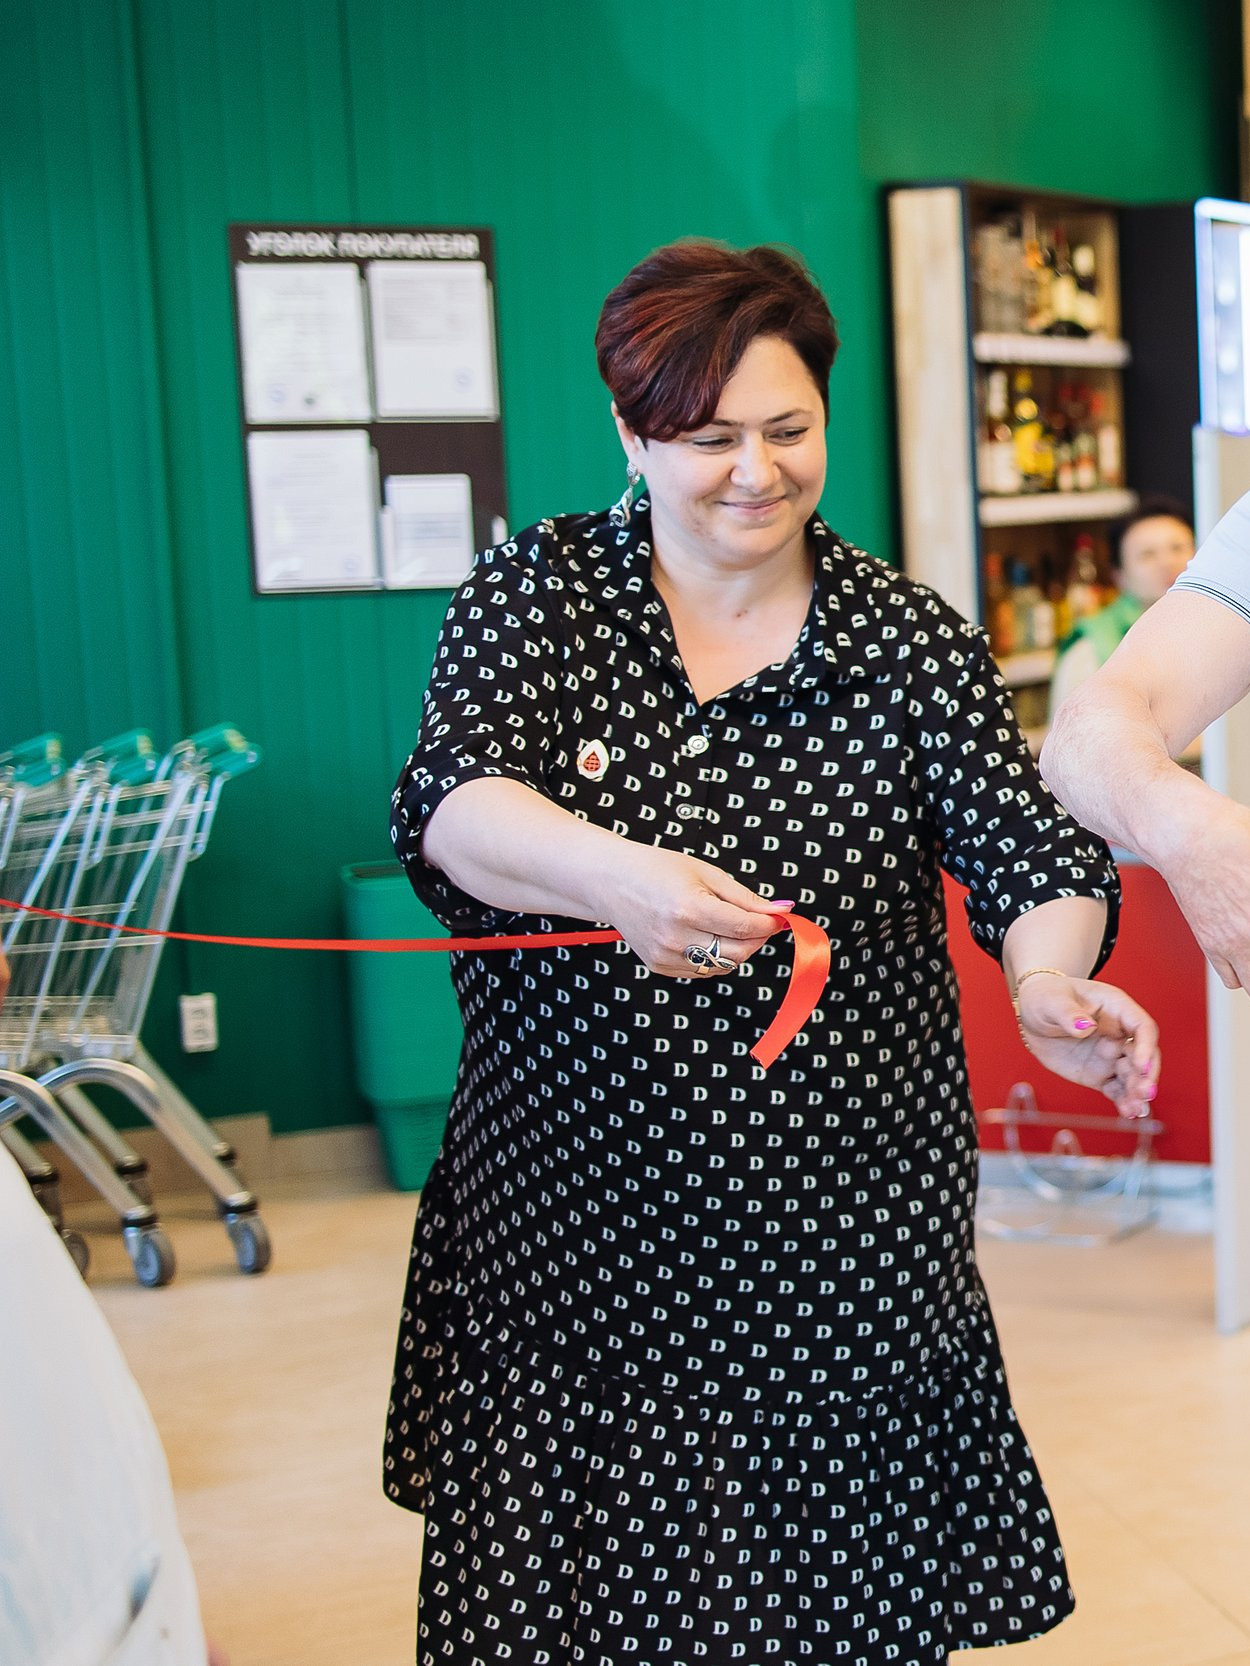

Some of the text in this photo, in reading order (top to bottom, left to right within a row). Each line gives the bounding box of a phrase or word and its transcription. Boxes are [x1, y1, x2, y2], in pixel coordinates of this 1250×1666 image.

[501, 542, 518, 558] D
[519, 577, 535, 594] D
[490, 591, 507, 605] D
[468, 607, 482, 619] D
[527, 606, 544, 623] D
[482, 628, 498, 642] D
[594, 624, 611, 638] D
[913, 631, 929, 645] D
[524, 640, 540, 657] D
[501, 653, 517, 668] D
[922, 657, 939, 674] D
[479, 666, 495, 680] D
[581, 665, 597, 681] D
[627, 661, 642, 677] D
[521, 681, 537, 699] D
[931, 686, 948, 704] D
[591, 694, 608, 711] D
[642, 691, 657, 707] D
[853, 694, 870, 708] D
[619, 701, 635, 718] D
[506, 714, 524, 727] D
[790, 712, 806, 726] D
[831, 717, 847, 731] D
[870, 715, 885, 729] D
[967, 712, 984, 727] D
[634, 732, 650, 749] D
[723, 727, 740, 742] D
[882, 734, 898, 748] D
[485, 740, 502, 758] D
[511, 734, 526, 750] D
[805, 737, 823, 752] D
[847, 740, 863, 754] D
[611, 747, 626, 761] D
[736, 752, 754, 767] D
[984, 752, 1002, 767] D
[649, 762, 666, 778] D
[779, 758, 797, 772] D
[821, 762, 839, 776] D
[710, 767, 728, 782] D
[419, 775, 433, 790] D
[440, 776, 456, 790] D
[560, 782, 576, 797] D
[624, 775, 641, 791] D
[675, 782, 691, 797] D
[794, 781, 812, 794] D
[876, 780, 892, 795] D
[598, 793, 614, 807] D
[727, 794, 744, 808] D
[996, 788, 1013, 804] D
[1016, 790, 1030, 806] D
[638, 805, 656, 820] D
[851, 802, 868, 816] D
[892, 807, 908, 822] D
[706, 809, 720, 824] D
[963, 809, 977, 825] D
[665, 821, 683, 836] D
[828, 822, 844, 837] D
[868, 827, 884, 841] D
[721, 835, 738, 848] D
[763, 836, 779, 851] D
[997, 838, 1016, 854] D
[703, 842, 719, 858] D
[804, 841, 821, 857] D
[846, 849, 861, 863] D
[740, 859, 756, 873] D
[782, 862, 798, 877] D
[823, 869, 839, 883] D
[1029, 873, 1048, 888] D
[758, 883, 774, 897] D
[799, 889, 815, 903] D
[739, 963, 753, 977] D
[655, 990, 669, 1004] D
[758, 987, 772, 1000] D
[634, 1013, 650, 1027] D
[674, 1015, 688, 1029] D
[714, 1018, 729, 1031] D
[655, 1039, 670, 1052] D
[693, 1040, 708, 1053] D
[732, 1042, 747, 1055] D
[674, 1063, 688, 1077] D
[712, 1064, 727, 1077] D
[693, 1087, 707, 1101] D
[731, 1088, 746, 1101] D
[771, 1090, 785, 1104] D
[630, 1100, 644, 1113] D
[713, 1110, 726, 1124] D
[789, 1114, 803, 1127] D
[648, 1125, 663, 1138] D
[731, 1134, 745, 1147] D
[667, 1150, 682, 1163] D
[750, 1156, 763, 1170] D
[839, 1215, 854, 1228] D
[630, 1322, 644, 1335] D
[775, 1324, 791, 1338] D
[703, 1381, 719, 1395] D
[744, 1387, 760, 1401] D
[641, 1399, 656, 1414] D
[513, 1424, 527, 1439] D
[652, 1426, 666, 1440] D
[684, 1432, 699, 1445] D
[732, 1435, 747, 1448] D
[521, 1453, 536, 1468] D
[609, 1464, 624, 1479] D
[639, 1472, 654, 1486] D
[444, 1480, 459, 1495] D
[726, 1481, 741, 1495] D
[812, 1483, 825, 1496] D
[504, 1497, 520, 1512] D
[617, 1491, 630, 1505] D
[451, 1509, 465, 1524] D
[595, 1510, 608, 1524] D
[831, 1505, 845, 1518] D
[628, 1518, 644, 1532] D
[515, 1526, 530, 1541] D
[722, 1528, 736, 1542] D
[813, 1529, 826, 1543] D
[489, 1542, 504, 1557] D
[641, 1543, 654, 1557] D
[430, 1551, 446, 1566] D
[526, 1555, 541, 1569] D
[586, 1555, 600, 1569] D
[833, 1551, 847, 1564] D
[499, 1570, 515, 1586] D
[618, 1565, 633, 1579] D
[717, 1575, 732, 1589] D
[889, 1573, 903, 1587] D
[434, 1581, 448, 1596] D
[475, 1585, 489, 1600] D
[632, 1590, 646, 1604] D
[666, 1591, 681, 1604] D
[767, 1594, 780, 1607] D
[834, 1596, 848, 1610] D
[547, 1605, 562, 1619] D
[608, 1611, 623, 1625] D
[484, 1614, 500, 1629] D
[680, 1615, 693, 1629] D
[713, 1622, 729, 1634] D
[522, 1626, 537, 1639] D
[496, 1643, 511, 1658] D
[622, 1637, 638, 1651] D
[658, 1638, 672, 1651] D
[694, 1642, 707, 1655] D
[731, 1643, 745, 1657] D
[837, 1641, 850, 1654] D
[534, 1651, 549, 1664] D
